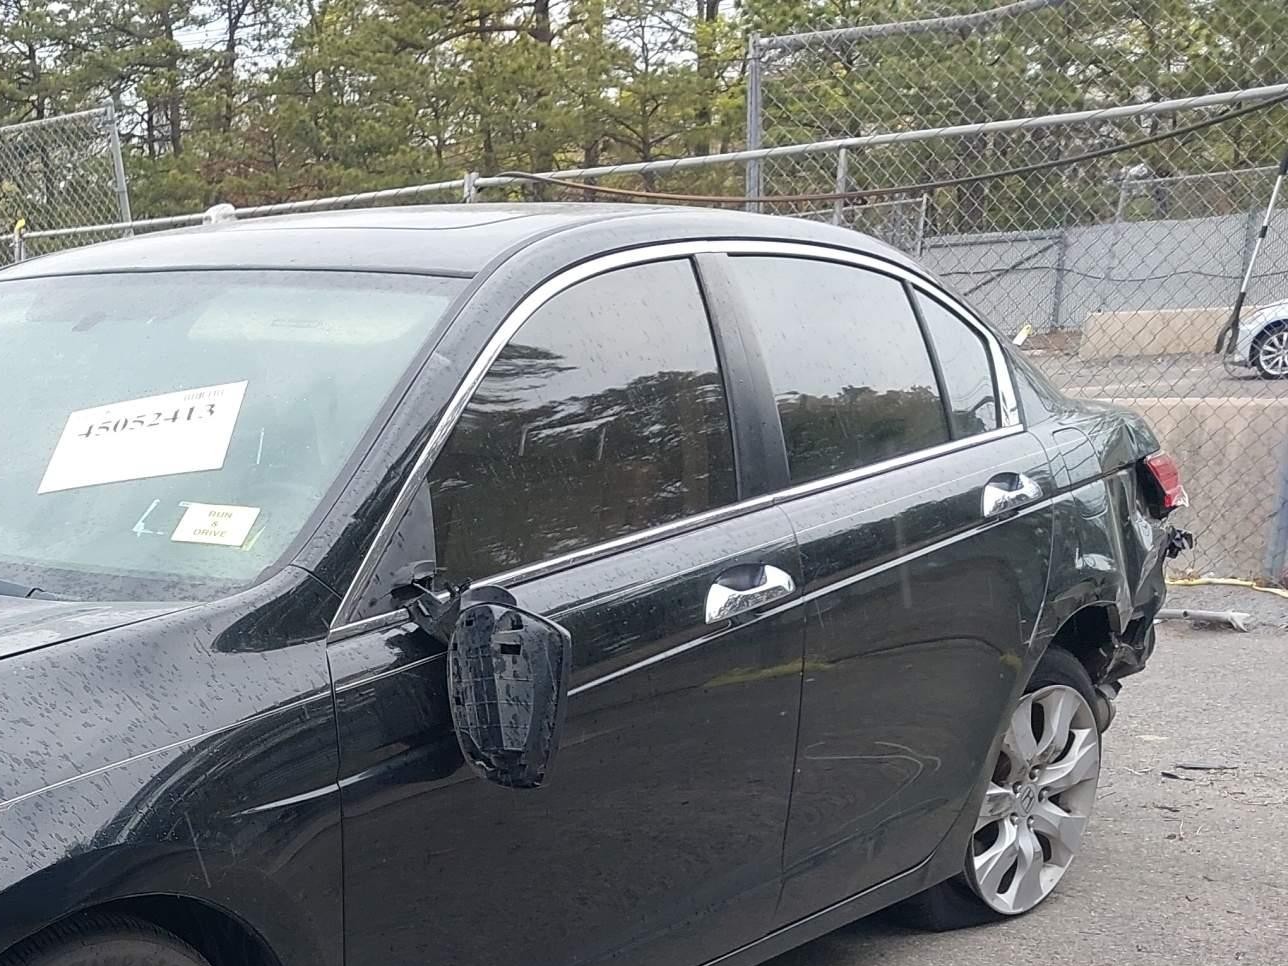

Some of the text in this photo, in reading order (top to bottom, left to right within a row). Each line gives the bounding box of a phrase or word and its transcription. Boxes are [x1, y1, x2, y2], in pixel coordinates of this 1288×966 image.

[77, 403, 216, 438] 45052413
[207, 510, 233, 519] RUN
[192, 528, 227, 538] DRIVE
